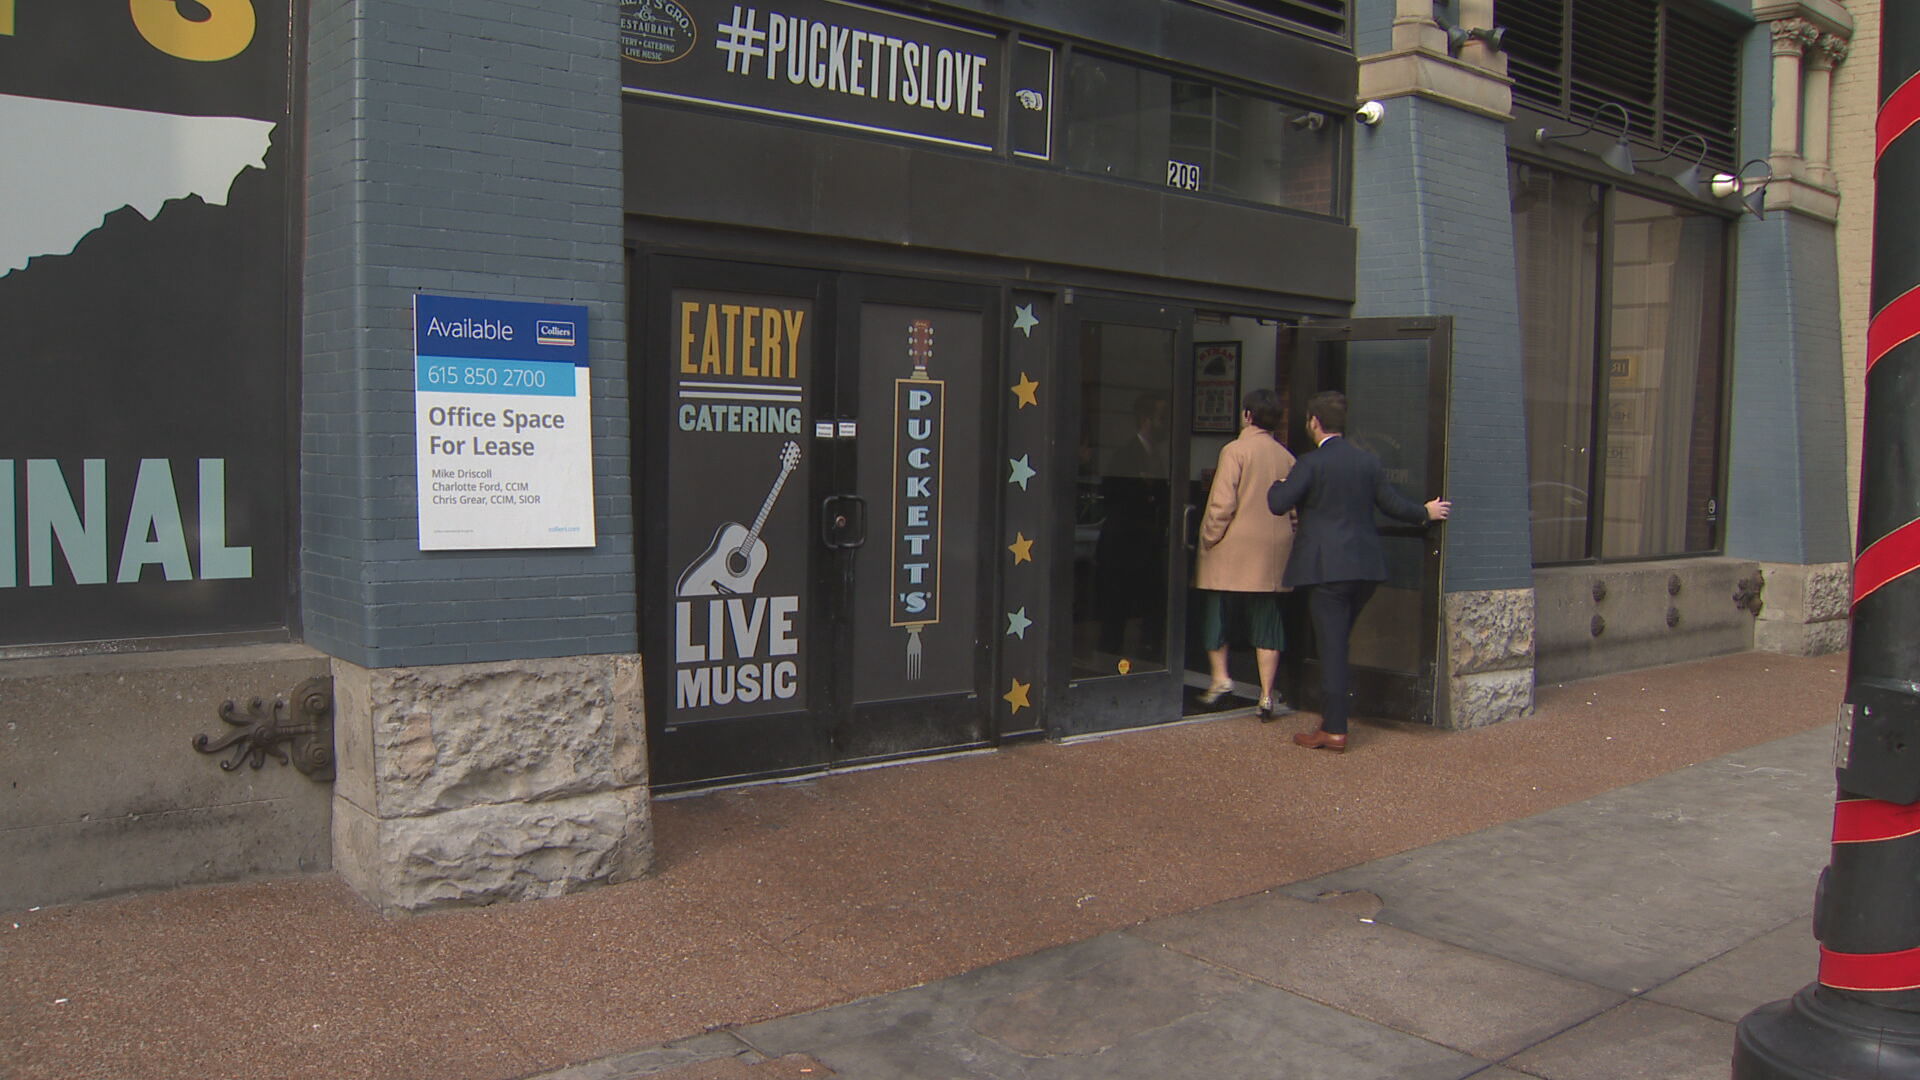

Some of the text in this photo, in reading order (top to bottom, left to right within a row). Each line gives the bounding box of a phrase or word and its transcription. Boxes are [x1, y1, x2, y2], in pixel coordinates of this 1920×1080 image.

[715, 5, 987, 118] #PUCKETTSLOVE
[1169, 162, 1197, 190] 209
[427, 316, 514, 341] Available
[540, 325, 571, 337] Colliers
[680, 301, 804, 378] EATERY
[428, 366, 546, 388] 615 850 2700
[428, 406, 565, 433] Office Space
[678, 404, 802, 434] CATERING
[430, 436, 535, 456] For Lease
[432, 469, 492, 479] Mike Driscoll
[432, 482, 529, 493] Charlotte Ford, CCIM
[432, 495, 541, 506] Chris Grear, CCIM, SIOR
[675, 595, 799, 663] LIVE
[676, 661, 798, 709] MUSIC
